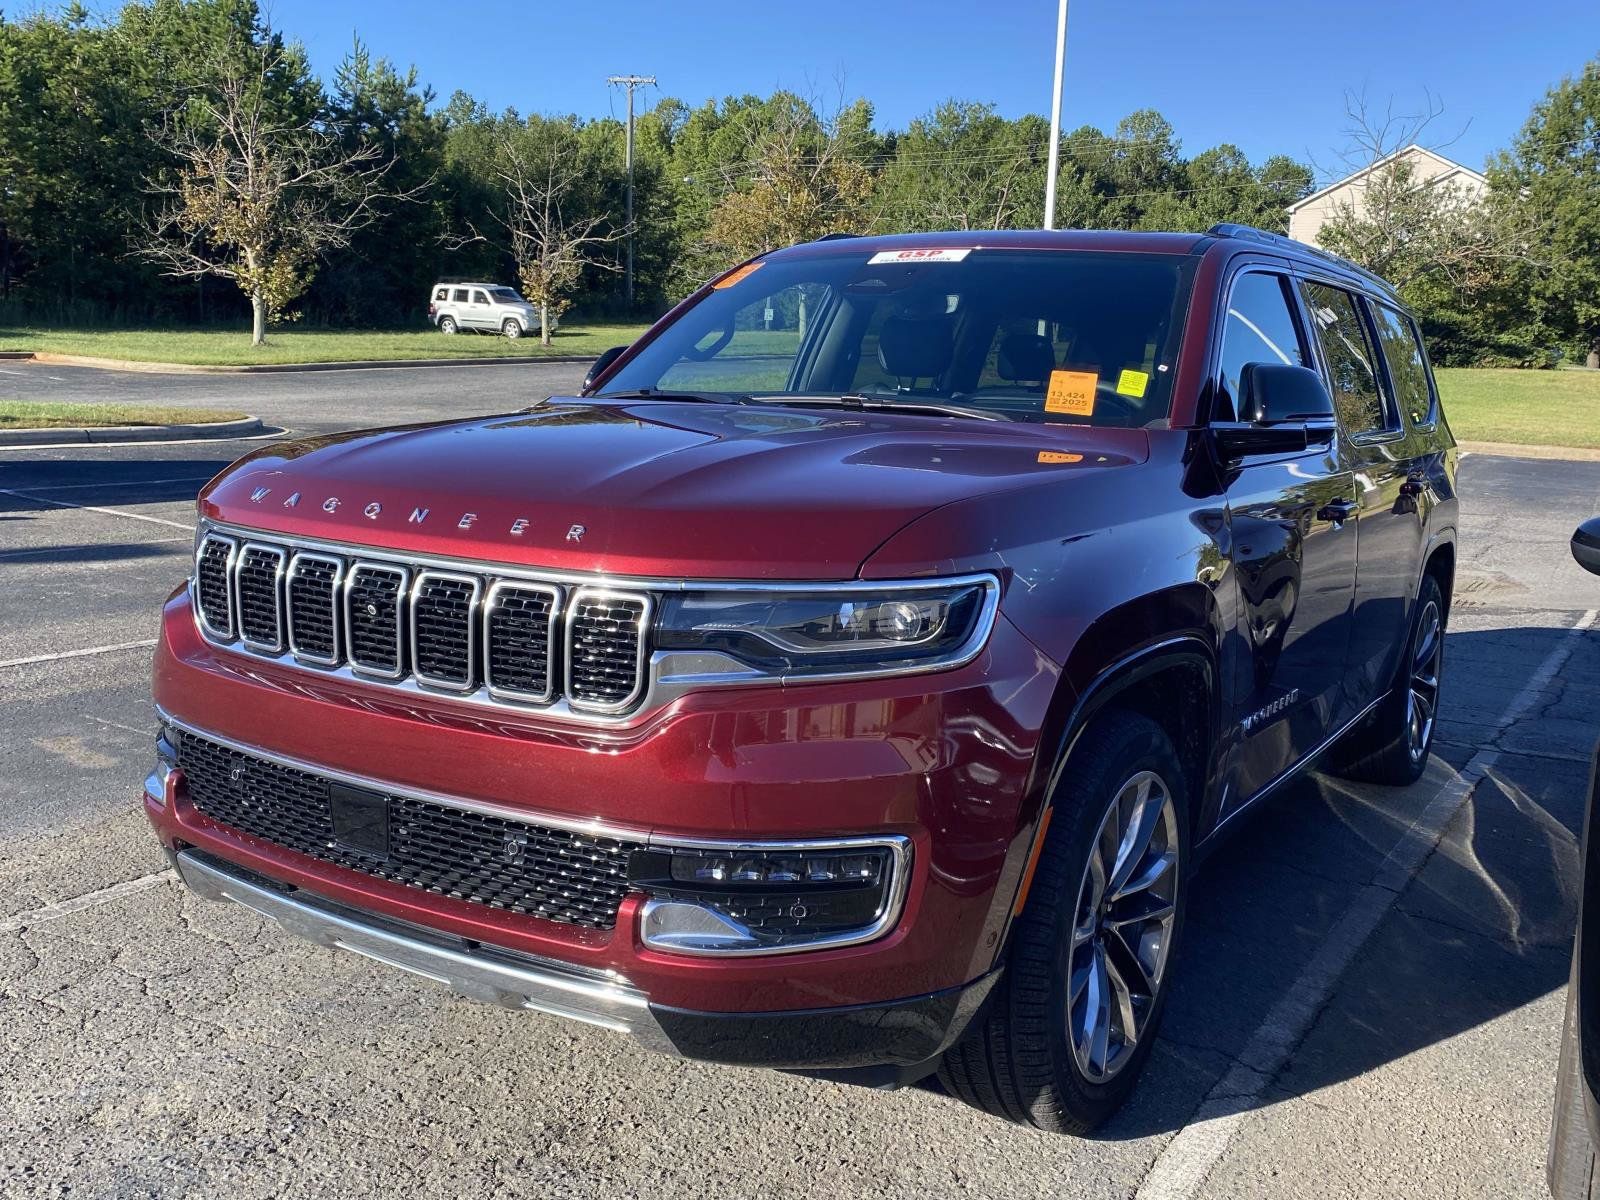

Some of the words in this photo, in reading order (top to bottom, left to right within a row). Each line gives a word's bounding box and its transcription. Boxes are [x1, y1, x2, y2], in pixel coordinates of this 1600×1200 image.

[897, 250, 943, 258] GSP
[1050, 391, 1085, 400] 13,424
[1061, 399, 1088, 407] 2025
[249, 486, 588, 542] WAGONEER
